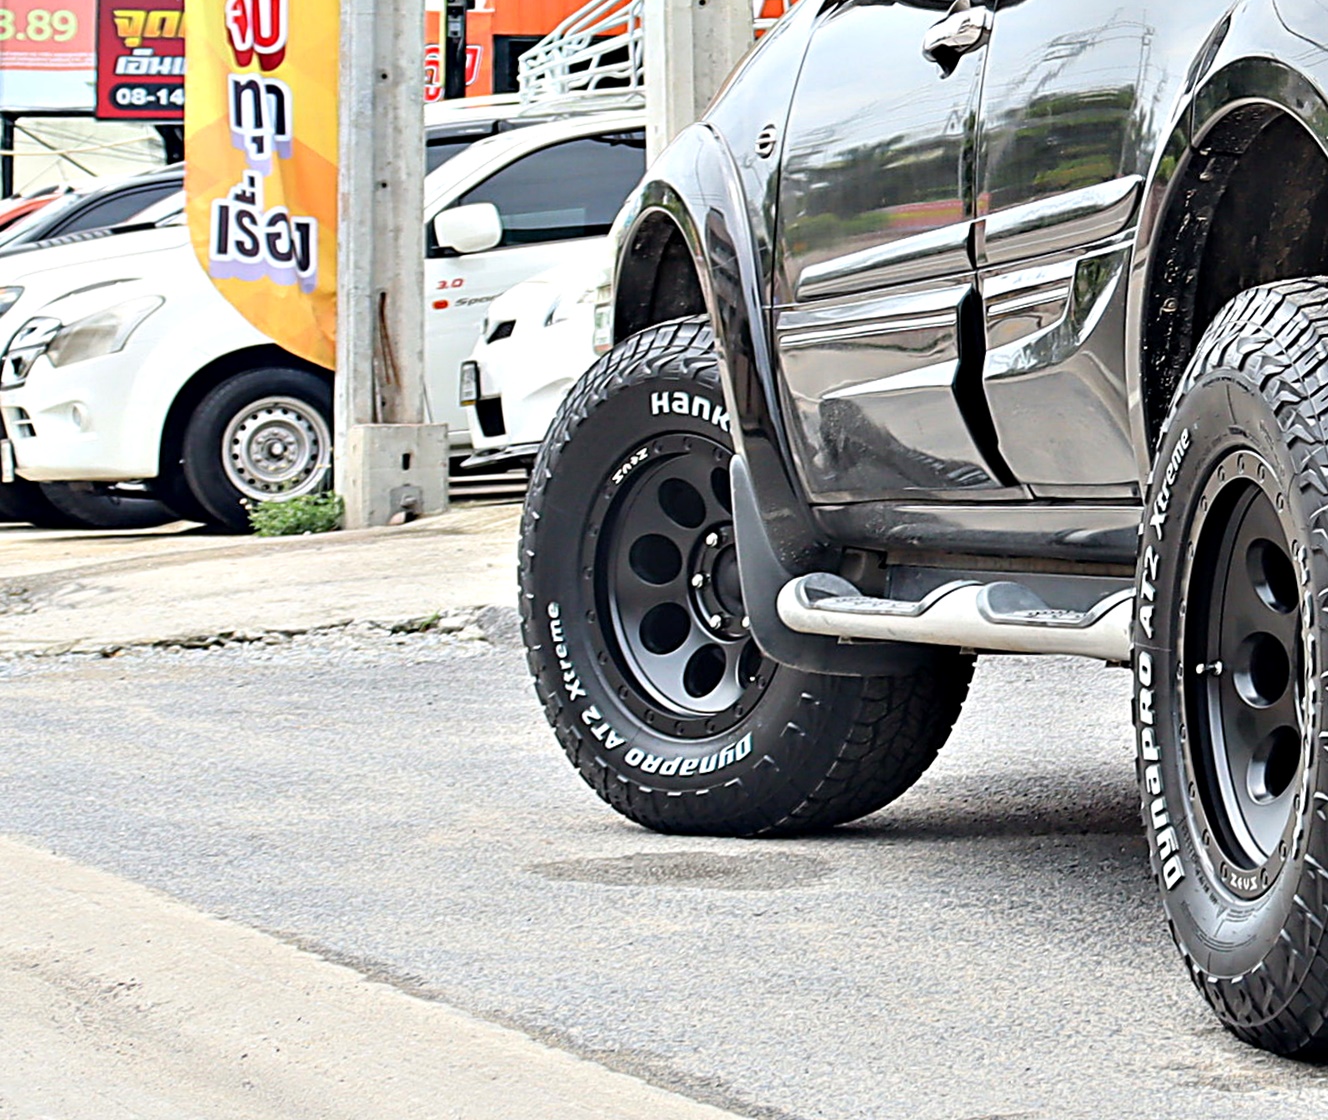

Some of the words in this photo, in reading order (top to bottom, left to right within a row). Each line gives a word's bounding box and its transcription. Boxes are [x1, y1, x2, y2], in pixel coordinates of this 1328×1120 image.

[230, 78, 288, 155] ทุก
[216, 174, 313, 273] เรื่อง
[1139, 545, 1160, 639] AT2
[581, 705, 625, 750] AT2
